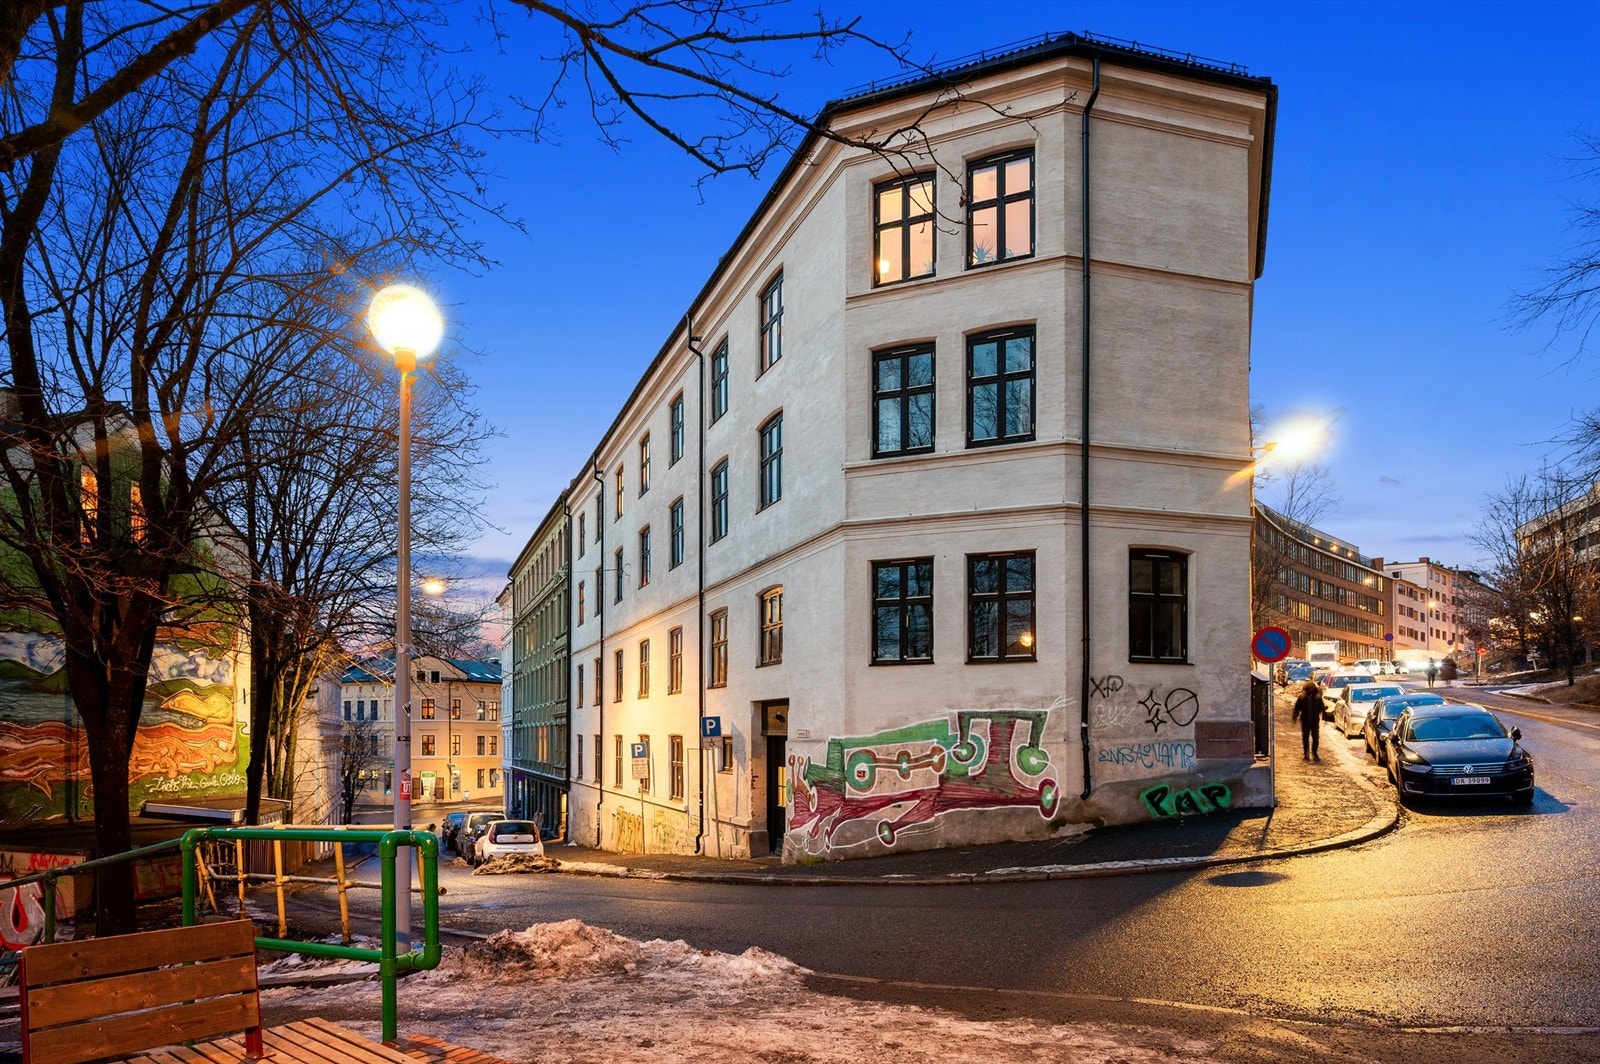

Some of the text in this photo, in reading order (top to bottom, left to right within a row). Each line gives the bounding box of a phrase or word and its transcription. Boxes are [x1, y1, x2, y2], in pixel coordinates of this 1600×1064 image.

[705, 719, 716, 735] P
[634, 745, 643, 757] P
[220, 769, 240, 786] Oslo
